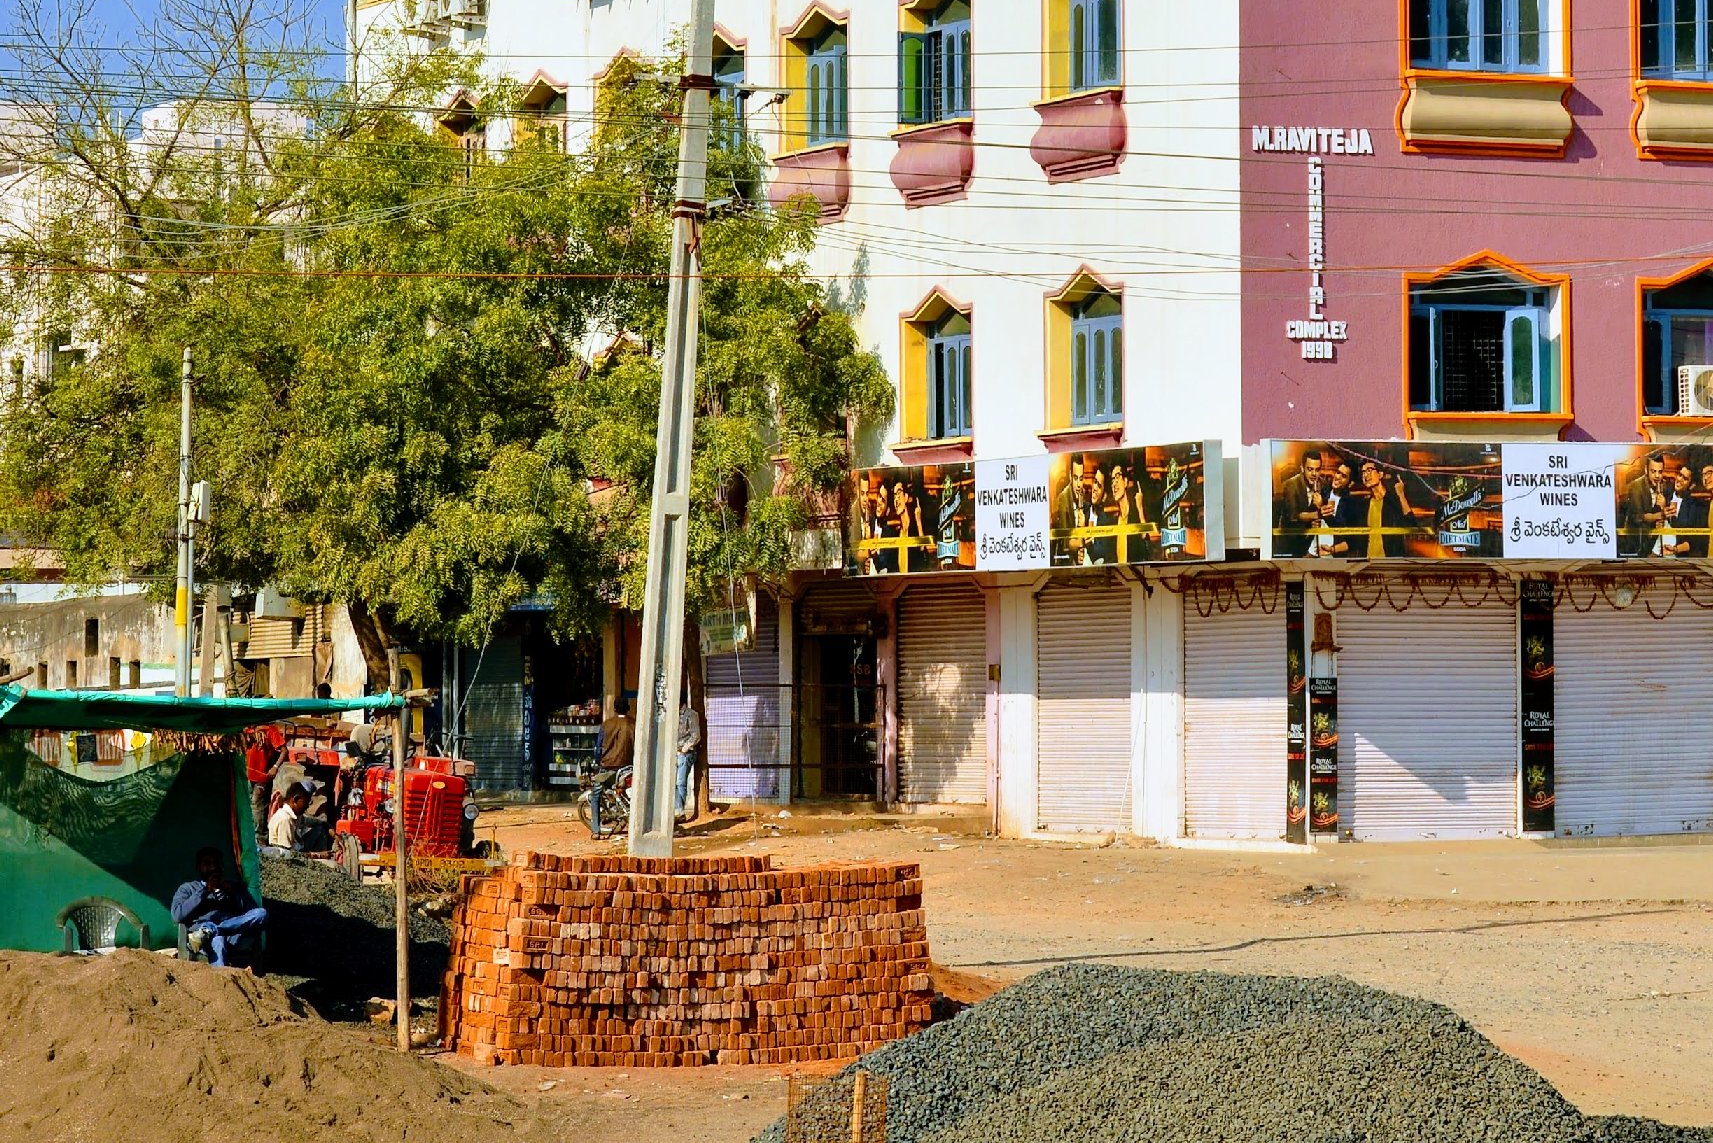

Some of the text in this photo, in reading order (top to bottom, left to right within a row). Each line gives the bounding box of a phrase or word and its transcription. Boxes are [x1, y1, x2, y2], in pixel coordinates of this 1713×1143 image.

[1286, 320, 1348, 340] COMPLEX
[1548, 456, 1568, 469] SRI
[1005, 464, 1018, 481] SRI
[1505, 473, 1612, 488] VENKATESHWARA
[977, 485, 1048, 507] VENKATESHWARA
[1540, 493, 1578, 507] WINES
[999, 512, 1025, 529] WINES
[1524, 719, 1554, 727] CHALLENG
